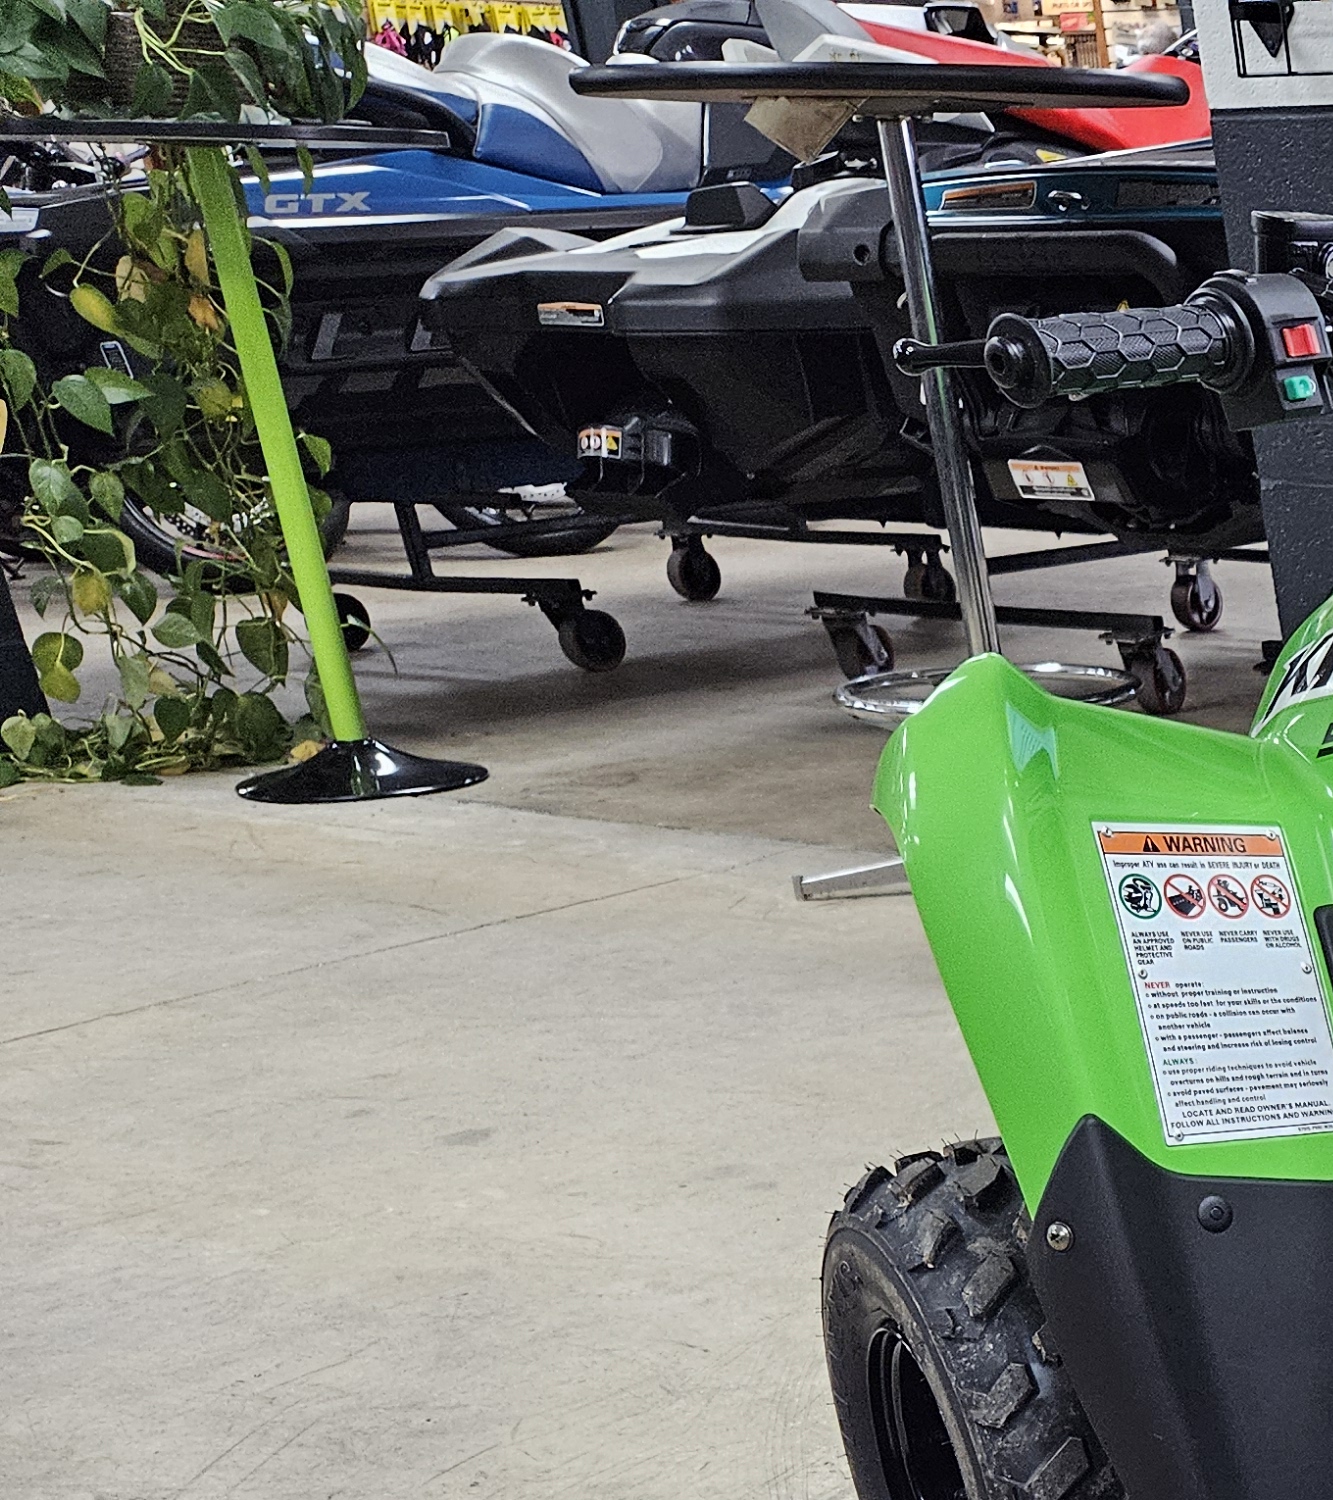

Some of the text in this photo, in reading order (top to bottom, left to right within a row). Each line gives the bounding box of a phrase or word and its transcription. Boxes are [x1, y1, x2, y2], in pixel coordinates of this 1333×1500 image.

[264, 191, 371, 214] GTX
[1163, 836, 1247, 853] WARNING
[1112, 860, 1140, 868] Improper
[1142, 860, 1154, 868] ATV
[1208, 861, 1230, 869] SEVERE
[1232, 861, 1252, 869] INJURY
[1262, 861, 1280, 869] DEATH
[1151, 990, 1178, 998] without
[1205, 988, 1232, 997] training
[1162, 1001, 1186, 1010] speeds
[1228, 1000, 1242, 1008] your
[1244, 998, 1261, 1006] skills
[1282, 996, 1317, 1004] conditions
[1166, 1012, 1187, 1020] public
[1280, 1006, 1296, 1014] with
[1158, 1022, 1185, 1030] another
[1160, 1034, 1177, 1042] with
[1184, 1032, 1219, 1042] passenger
[1224, 1030, 1262, 1040] passengers
[1262, 1028, 1282, 1036] affect
[1177, 1043, 1206, 1052] steering
[1221, 1041, 1250, 1049] increase
[1250, 1040, 1263, 1048] risk
[1272, 1038, 1292, 1048] losing
[1294, 1036, 1317, 1044] control
[1182, 1068, 1204, 1076] proper
[1206, 1066, 1226, 1074] riding
[1228, 1063, 1264, 1072] techniques
[1170, 1078, 1204, 1086] overturns
[1245, 1074, 1265, 1083] rough
[1266, 1072, 1289, 1080] terrain
[1173, 1080, 1328, 1097] avoid paved surfaces pavement may seriously
[1175, 1094, 1266, 1108] affect handling and control
[1182, 1110, 1214, 1118] LOCATE
[1216, 1108, 1232, 1116] AND
[1234, 1106, 1256, 1114] READ
[1258, 1102, 1293, 1112] OWNER'S
[1170, 1120, 1204, 1129] FOLLOW
[1206, 1118, 1220, 1126] ALL
[1222, 1114, 1281, 1124] INSTRUCTIONS
[1282, 1112, 1300, 1120] AND
